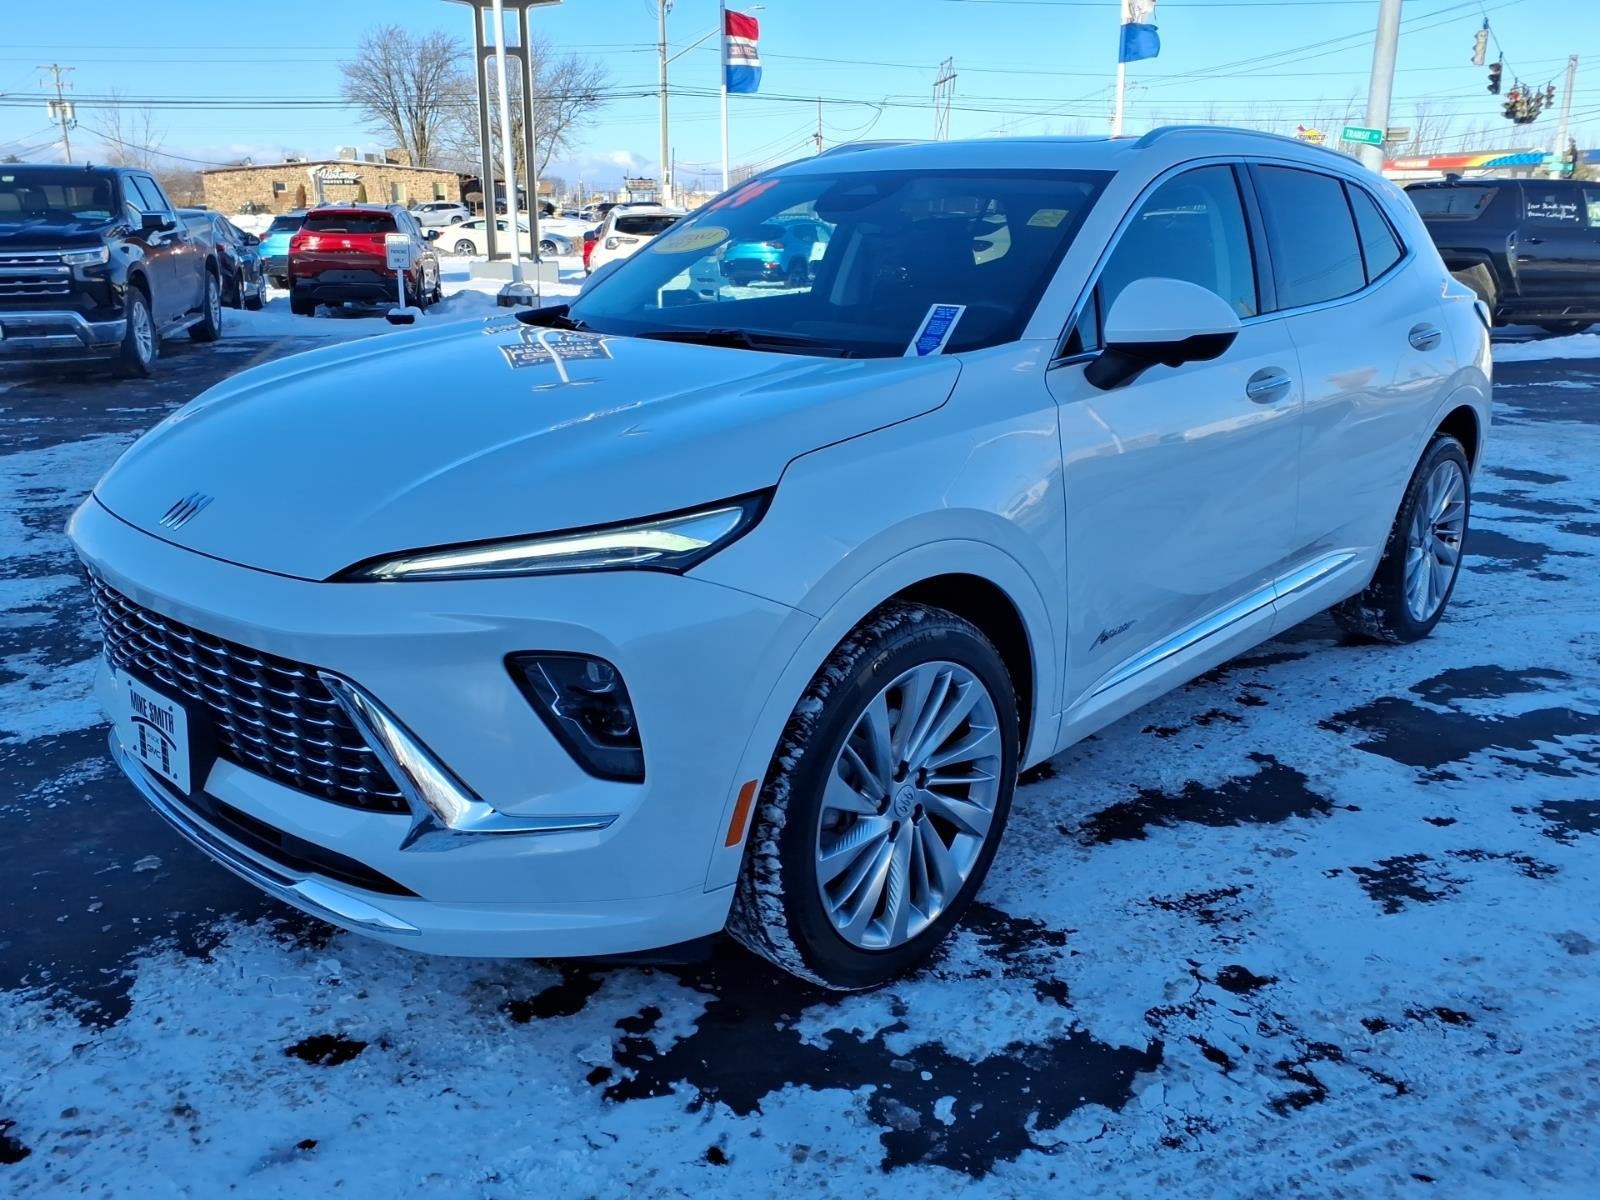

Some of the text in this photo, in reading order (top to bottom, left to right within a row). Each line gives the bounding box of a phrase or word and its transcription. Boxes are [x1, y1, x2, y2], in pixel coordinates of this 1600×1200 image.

[1345, 129, 1371, 140] TRANSIT
[130, 689, 175, 734] MIKE SMITH
